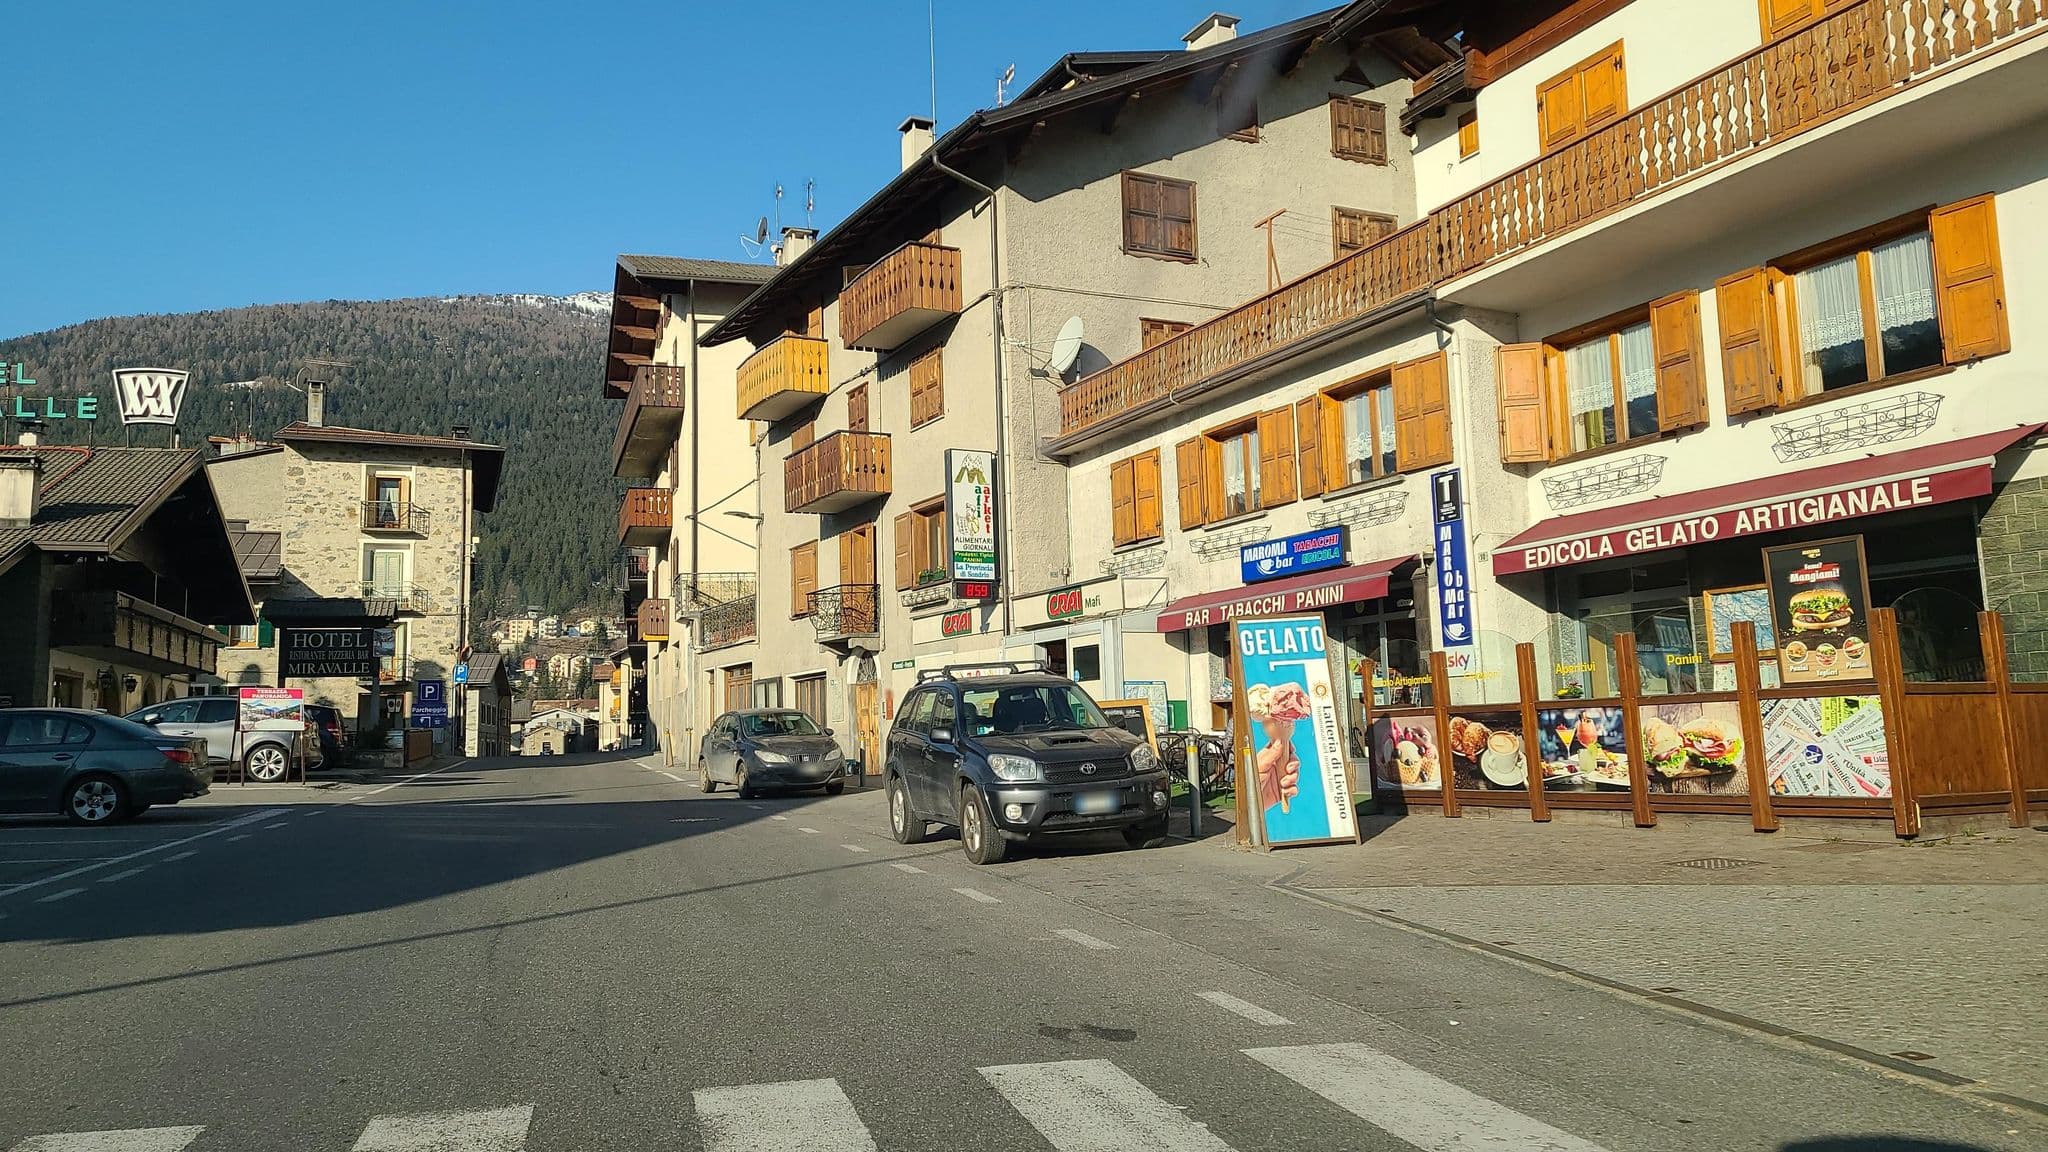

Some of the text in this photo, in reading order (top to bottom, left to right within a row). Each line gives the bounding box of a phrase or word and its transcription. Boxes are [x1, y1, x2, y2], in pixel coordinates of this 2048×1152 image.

[1438, 474, 1454, 502] T
[1525, 477, 1933, 569] EDICOLA GELATO ARTIGIANALE
[955, 536, 992, 544] ALIMENTARI
[1243, 534, 1339, 563] MAROMA TABACCHI
[1275, 547, 1340, 569] bar EDICOLA
[1440, 525, 1456, 619] MAROMA
[1790, 568, 1840, 583] Mangiami!
[1048, 589, 1101, 617] CRAI Mafi
[1455, 570, 1464, 618] bar
[1185, 584, 1344, 627] BAR TABACCHI PANINI
[944, 612, 972, 634] CRAI
[291, 632, 368, 648] HOTEL
[1240, 626, 1325, 656] GELATO
[290, 650, 369, 660] RISTORANTE PIZZERIA BAR
[1448, 651, 1470, 671] sky
[1666, 653, 1703, 666] Panini
[288, 662, 370, 674] MIRAVALLE
[458, 666, 464, 675] P
[1555, 662, 1596, 676] Aperitivi
[425, 686, 434, 698] P
[412, 706, 447, 714] Parcheggio
[1323, 705, 1348, 820] Latteria di Livigno
[1830, 759, 1857, 794] manifesto
